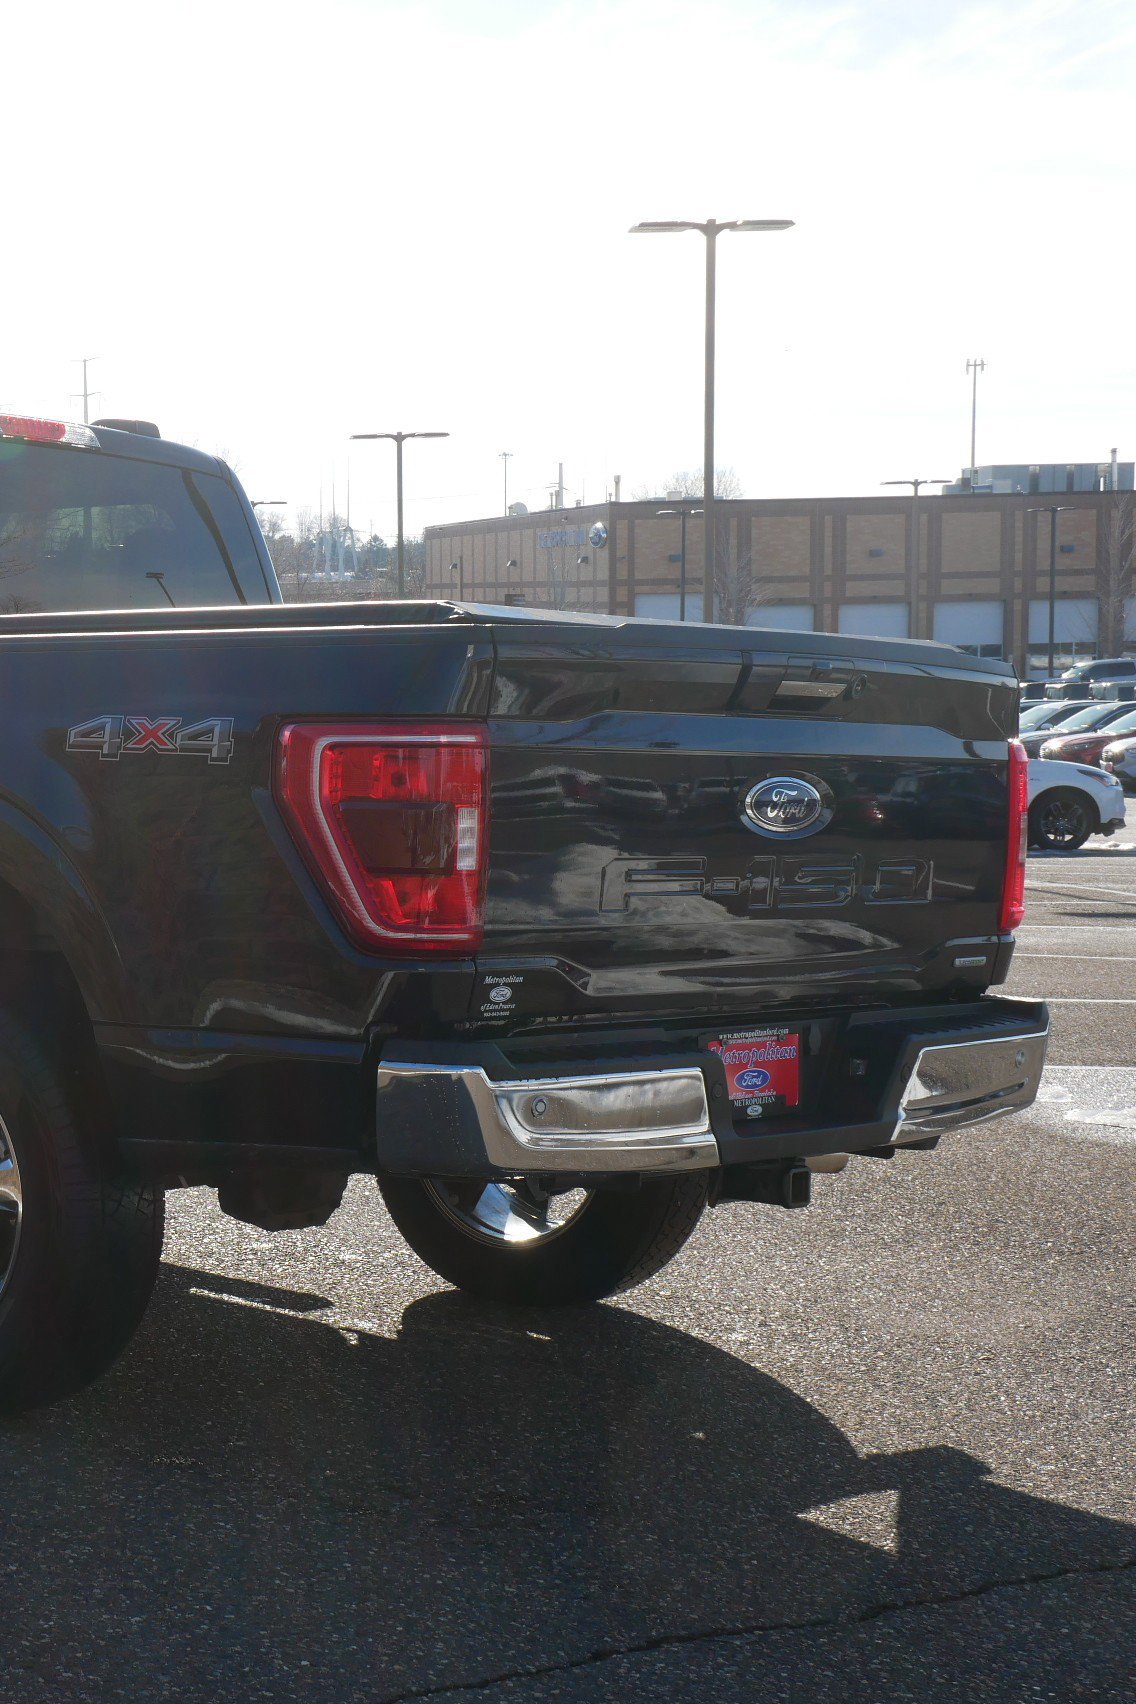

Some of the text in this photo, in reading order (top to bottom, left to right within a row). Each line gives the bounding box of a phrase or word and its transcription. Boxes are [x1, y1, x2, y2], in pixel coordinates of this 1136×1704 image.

[767, 788, 808, 818] Ford
[599, 853, 933, 914] F-150
[483, 974, 524, 985] Metropolitan
[741, 1072, 763, 1086] Ford
[733, 1096, 776, 1107] METROPOLITAN
